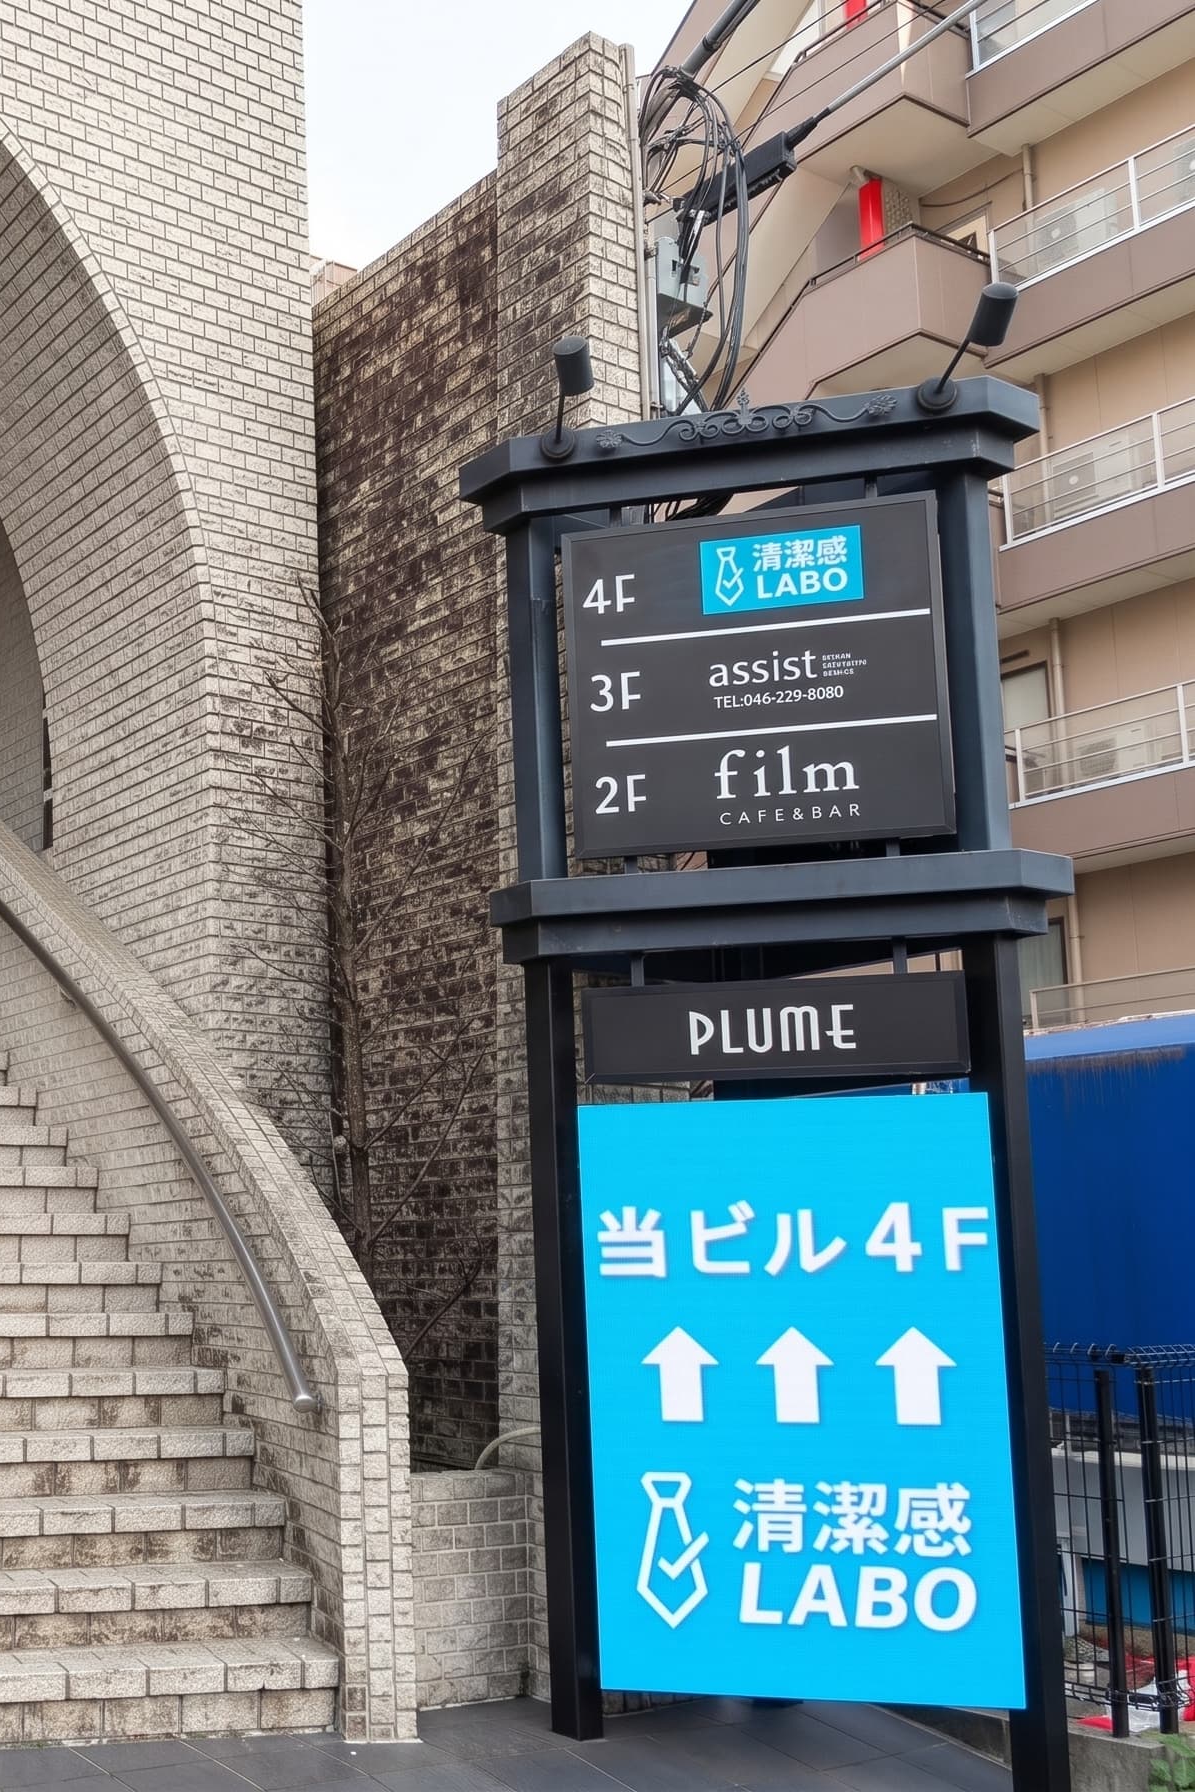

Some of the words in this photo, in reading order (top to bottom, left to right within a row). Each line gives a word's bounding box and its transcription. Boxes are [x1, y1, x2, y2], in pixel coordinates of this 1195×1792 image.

[751, 535, 848, 574] 清潔感
[582, 573, 635, 615] 4F
[756, 567, 848, 600] LABO
[708, 650, 817, 688] assist
[590, 671, 641, 713] 3F
[713, 684, 844, 710] TEL:046-229-8080
[714, 745, 860, 800] film
[595, 774, 647, 815] 2F
[719, 802, 861, 826] CAFE&BAR
[688, 1003, 857, 1056] PLUME
[732, 1478, 973, 1557] 清潔感
[739, 1562, 978, 1632] LABO
